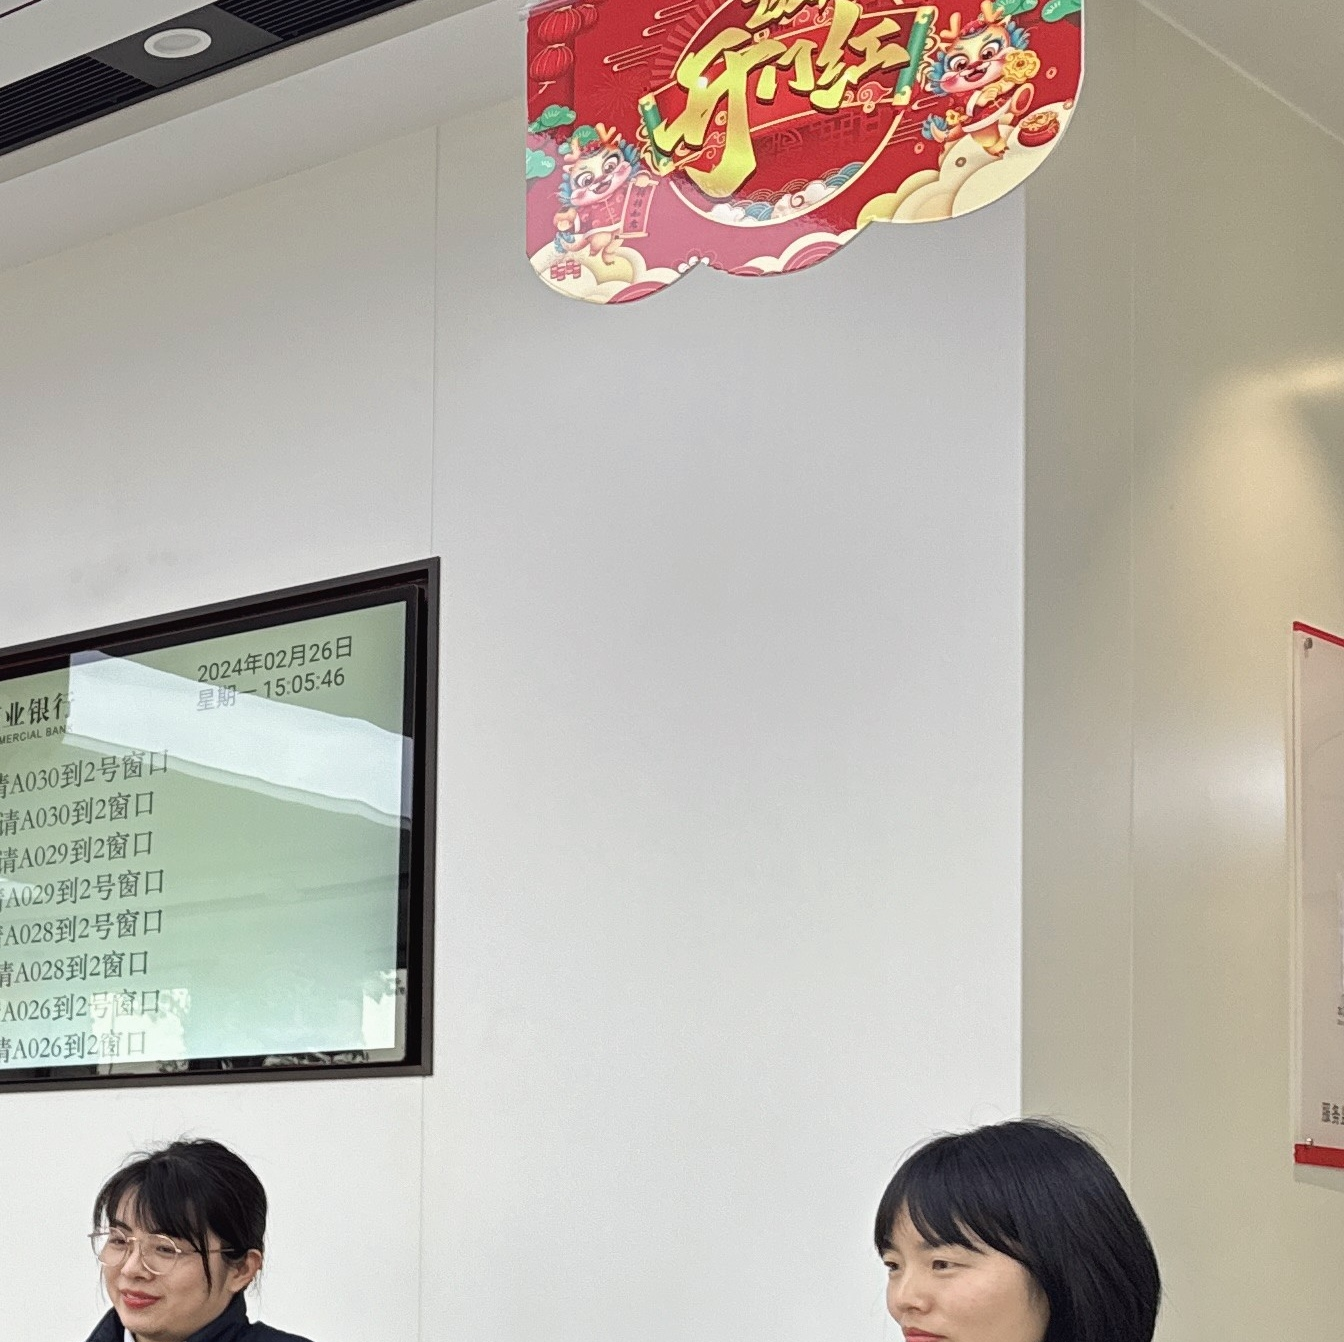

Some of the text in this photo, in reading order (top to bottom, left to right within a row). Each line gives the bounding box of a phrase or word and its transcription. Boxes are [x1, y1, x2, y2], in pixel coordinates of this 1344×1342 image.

[197, 635, 353, 683] 2024年02月26日
[196, 667, 346, 711] 星期一 15:05:46
